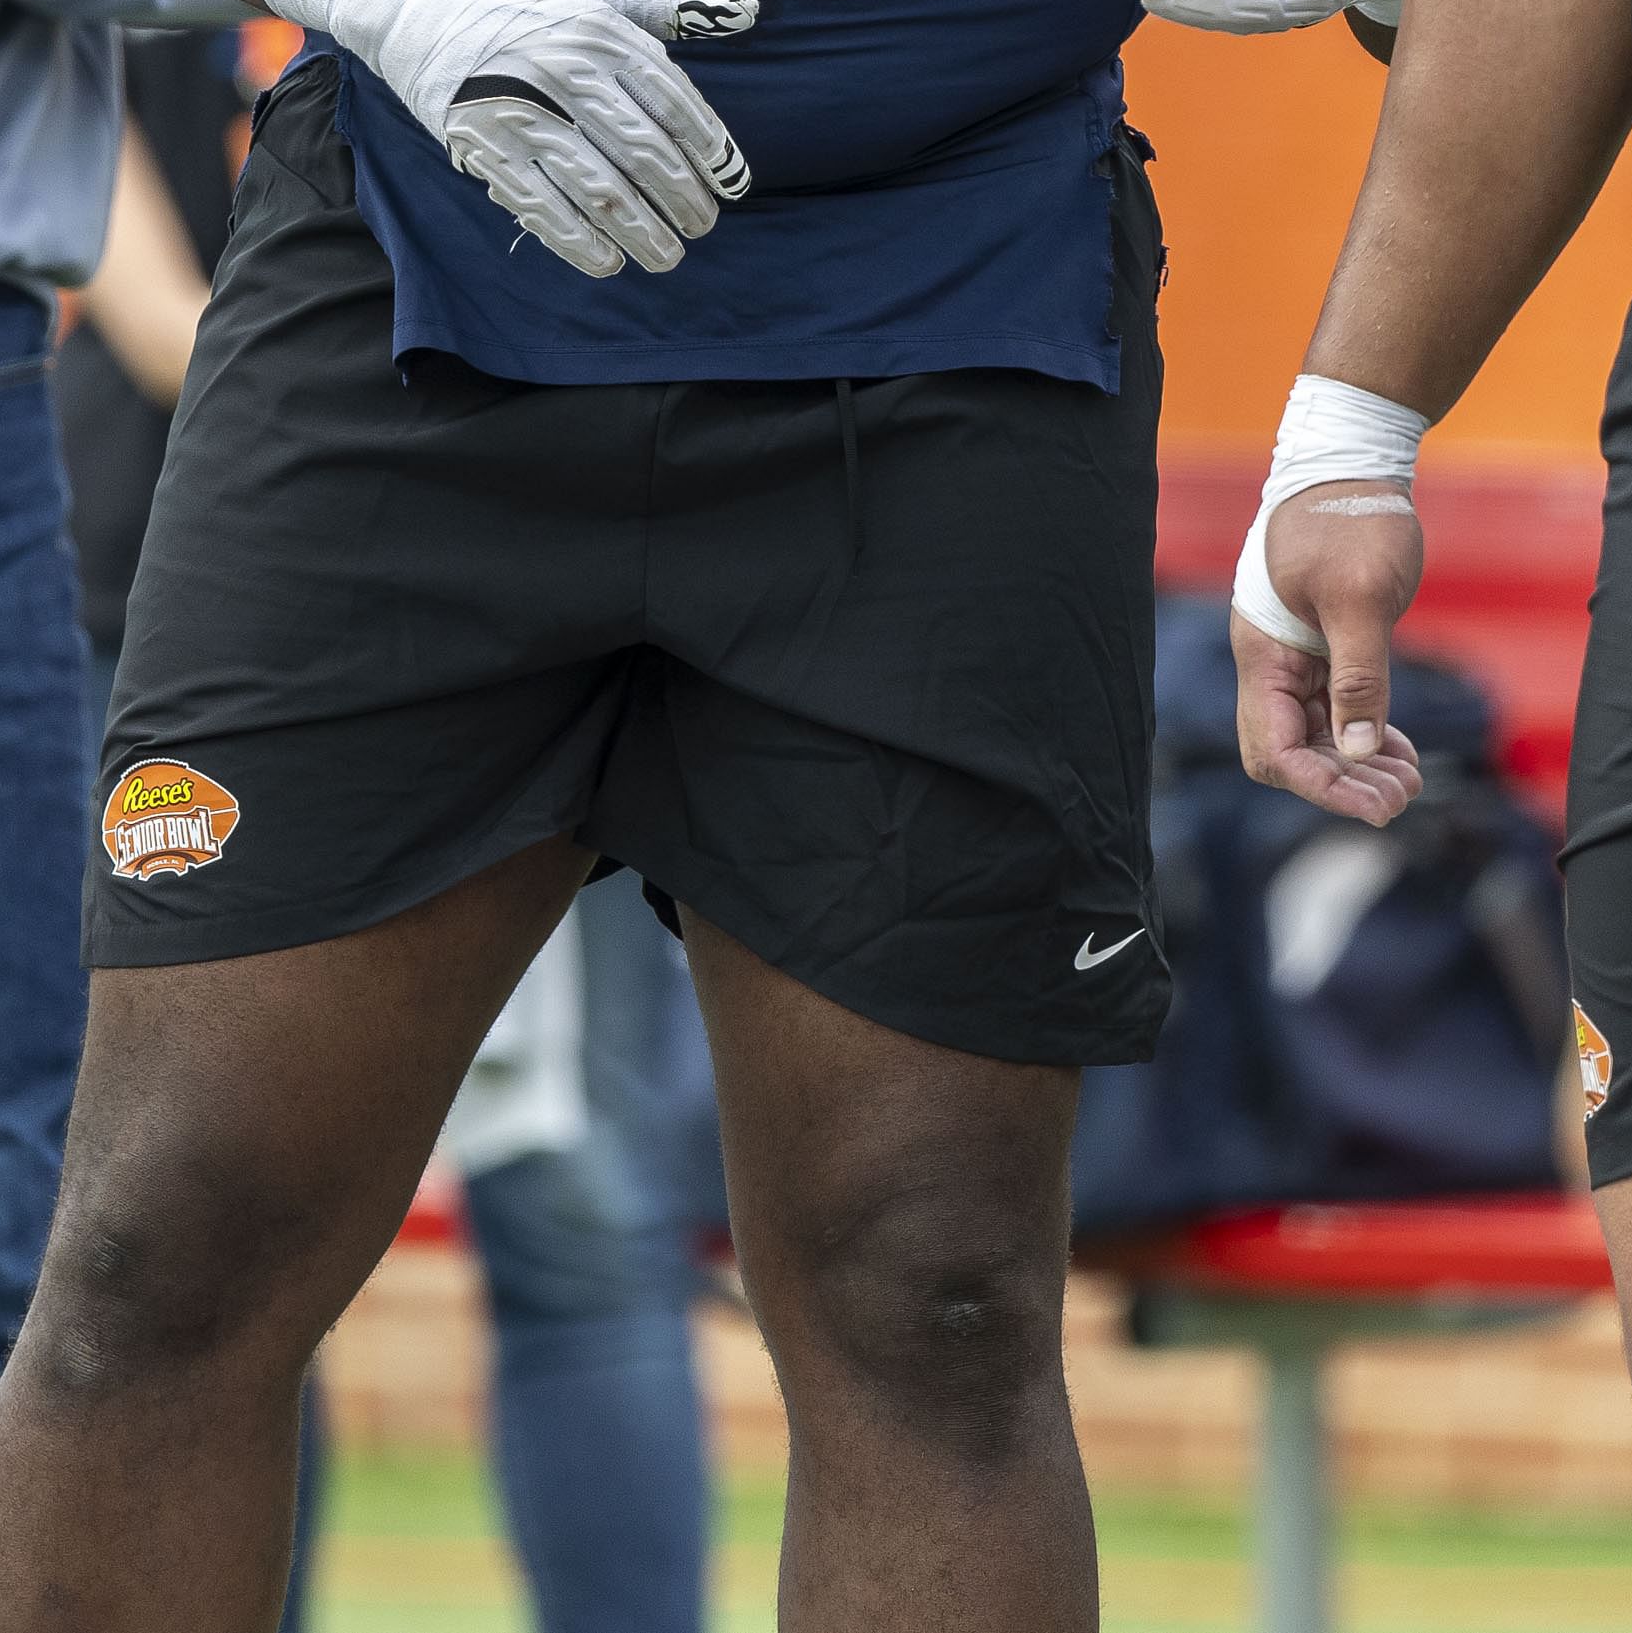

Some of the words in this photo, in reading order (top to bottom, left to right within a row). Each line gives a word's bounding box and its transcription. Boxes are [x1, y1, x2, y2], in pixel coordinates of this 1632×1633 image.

[122, 776, 194, 815] Reese's
[116, 817, 167, 869] SENIOR
[165, 810, 218, 853] BOWL
